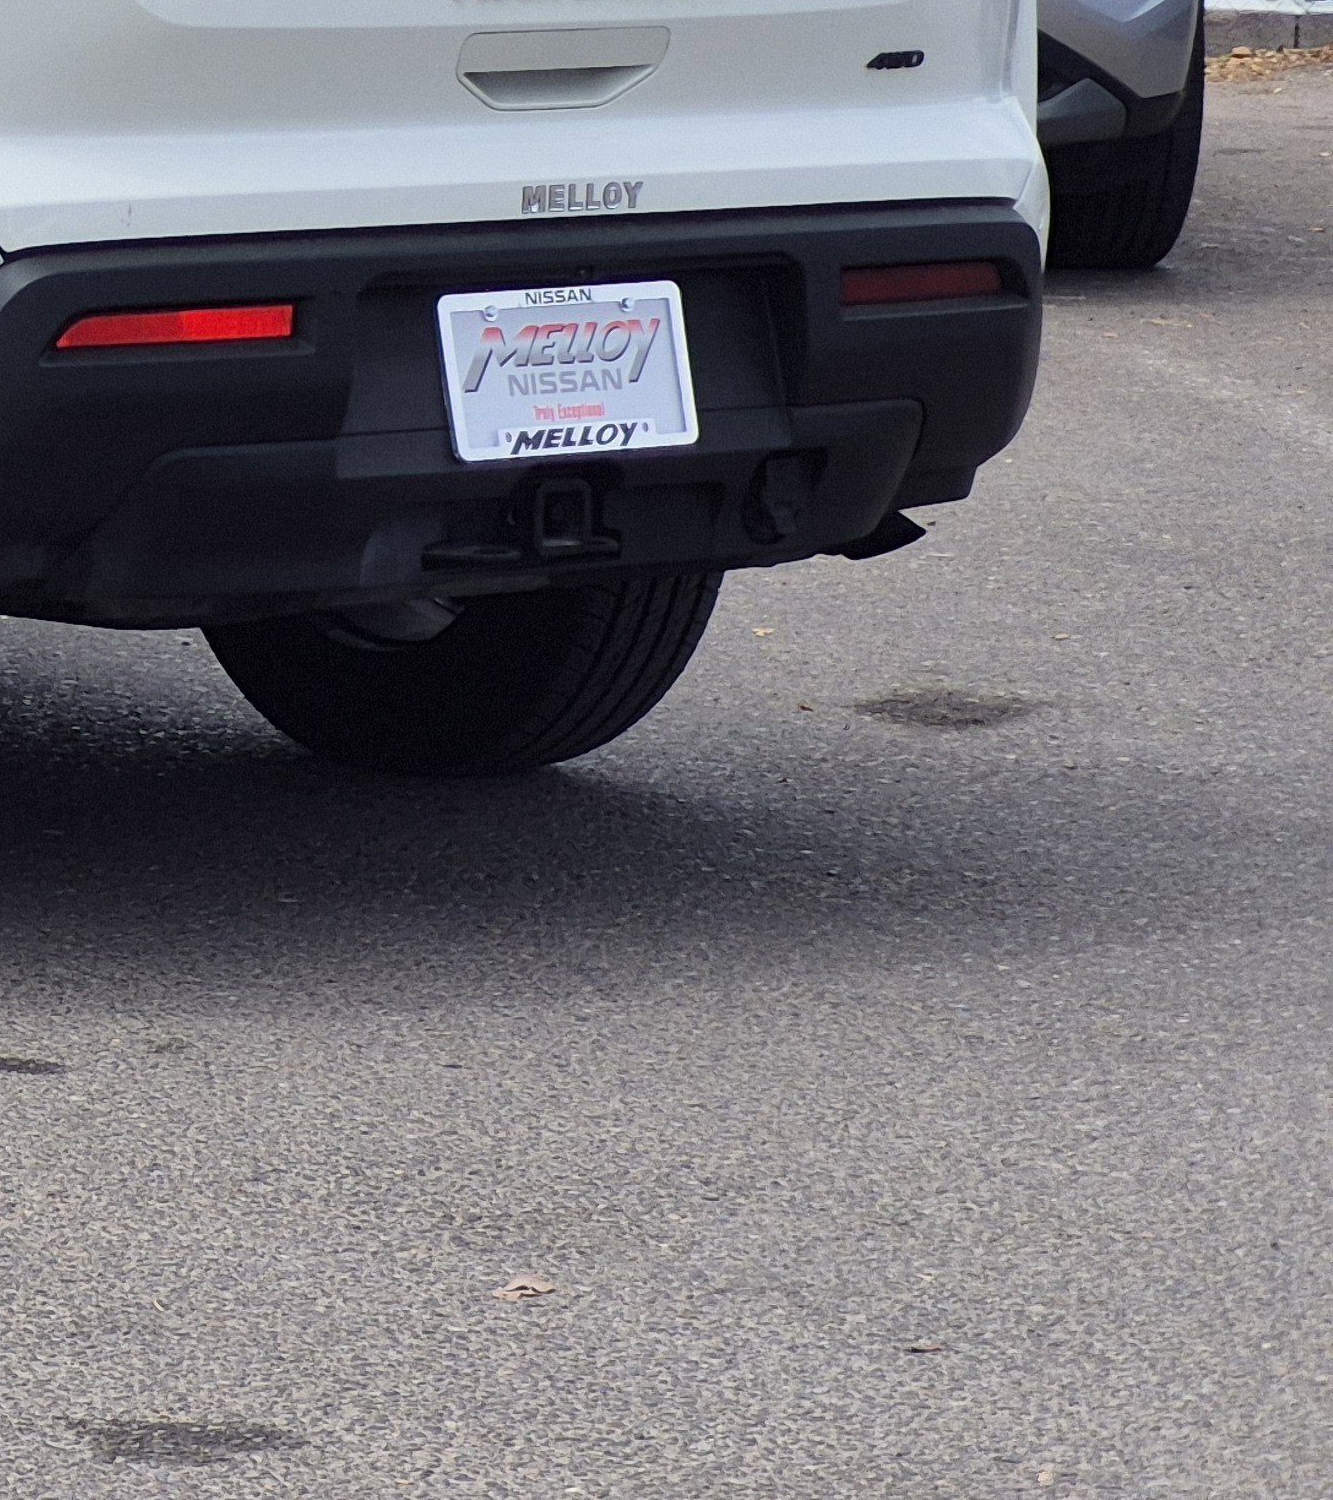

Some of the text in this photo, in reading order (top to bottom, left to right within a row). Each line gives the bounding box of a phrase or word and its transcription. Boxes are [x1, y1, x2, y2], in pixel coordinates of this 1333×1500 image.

[521, 181, 644, 215] MELLOY
[524, 288, 593, 306] NISSAN
[462, 318, 661, 393] MELLOY
[508, 368, 623, 397] NISSAN
[510, 422, 638, 455] MELLOY
